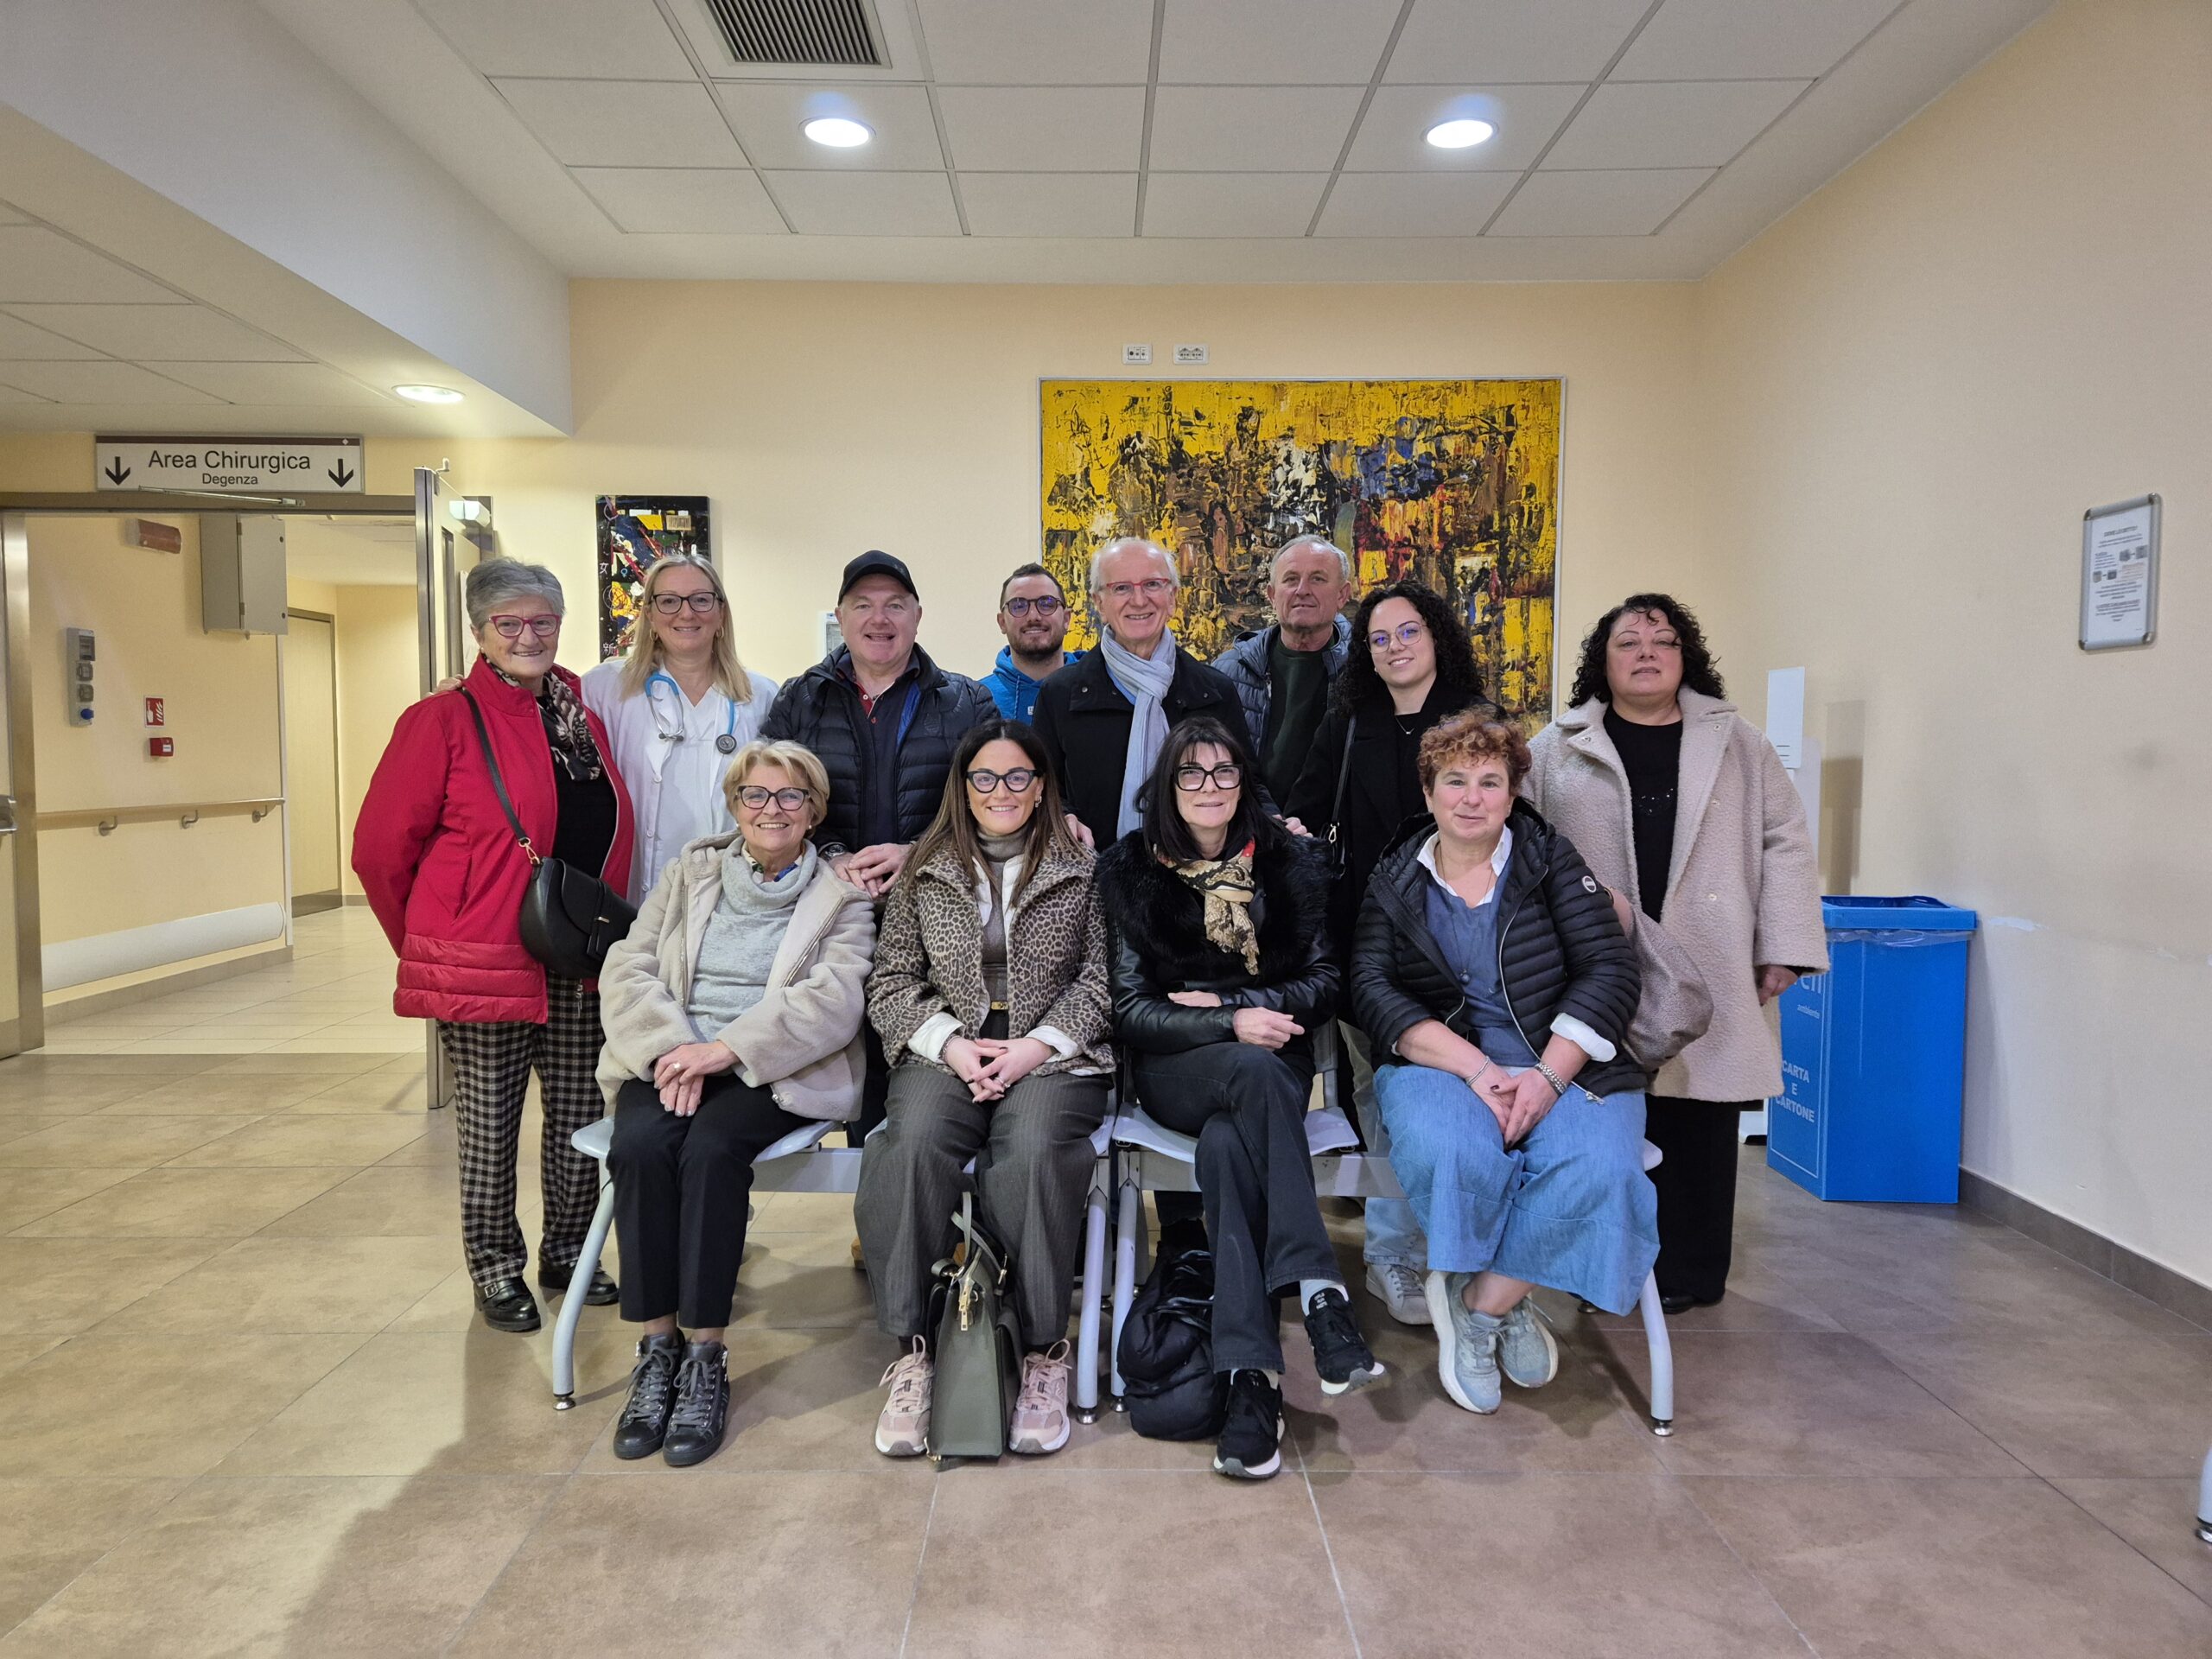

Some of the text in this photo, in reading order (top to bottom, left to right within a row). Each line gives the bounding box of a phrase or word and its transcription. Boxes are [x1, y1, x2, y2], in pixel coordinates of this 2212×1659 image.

[148, 449, 311, 474] Area Chirurgica
[201, 473, 258, 488] Degenza
[1782, 1059, 1810, 1084] CARTA
[1791, 1082, 1798, 1096] E
